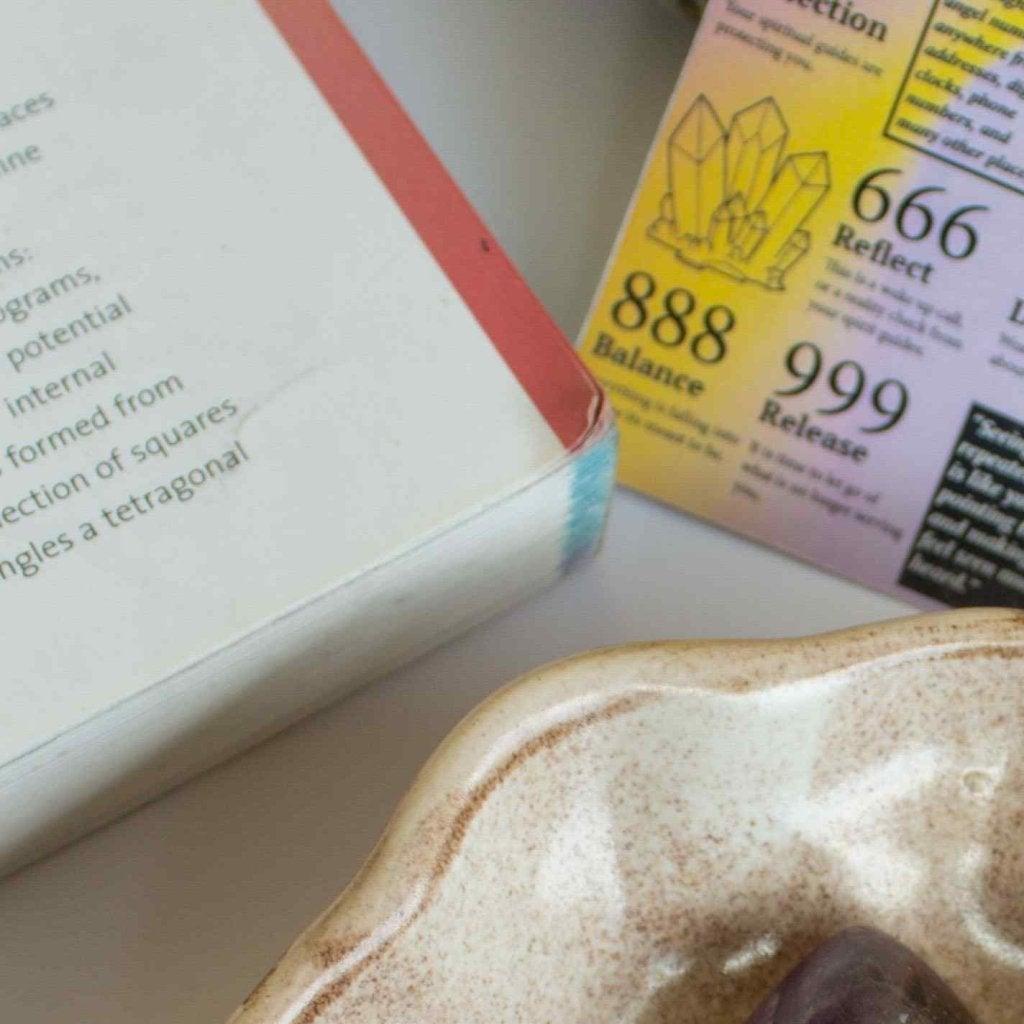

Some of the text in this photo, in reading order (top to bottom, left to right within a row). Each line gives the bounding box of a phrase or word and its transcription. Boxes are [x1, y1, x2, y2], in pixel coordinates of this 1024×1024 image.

[834, 224, 934, 283] Reflect
[851, 168, 990, 259] 666
[6, 293, 132, 373] potential
[612, 271, 736, 365] 888
[3, 350, 116, 418] internal
[594, 334, 704, 394] Balance
[776, 343, 908, 433] 999
[0, 397, 239, 528] ection of squares
[5, 375, 183, 468] formed from
[760, 400, 866, 460] Release
[78, 522, 98, 541] a
[102, 440, 250, 530] tetragonal
